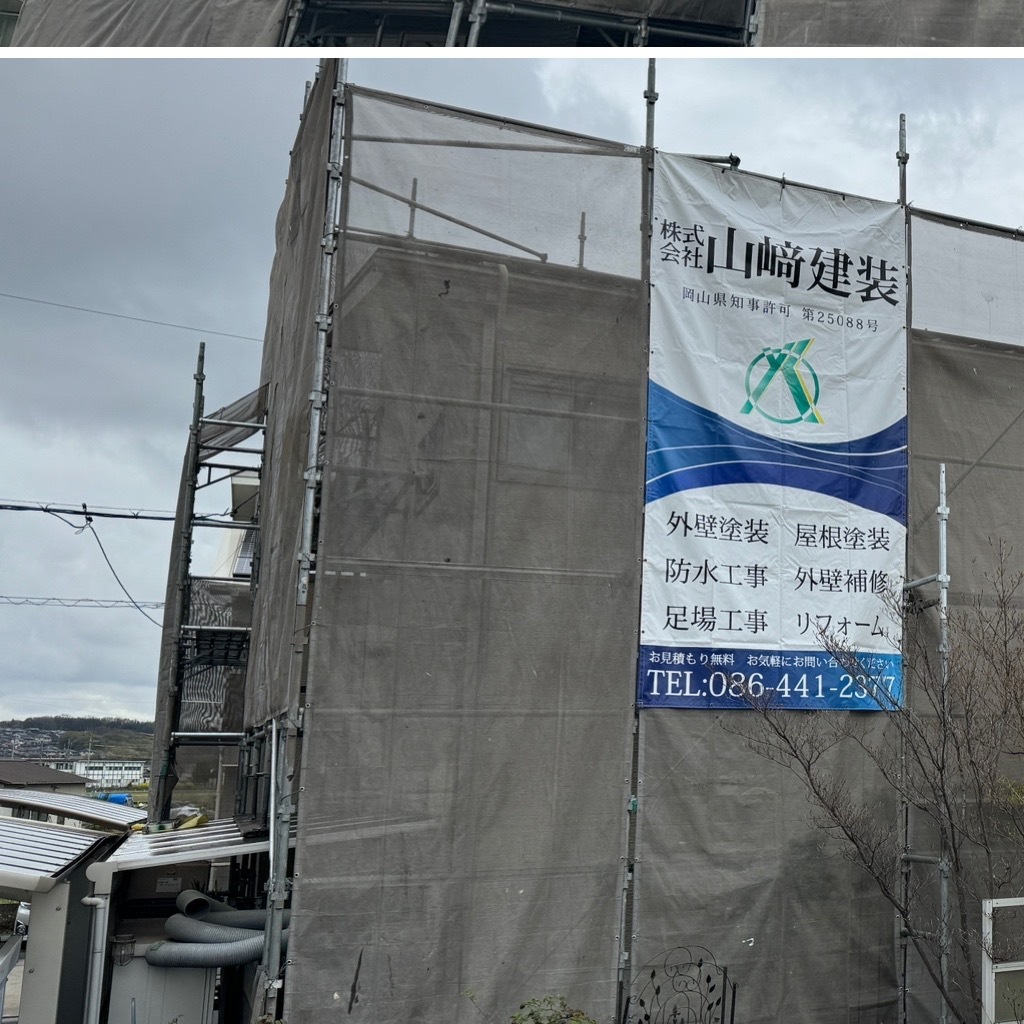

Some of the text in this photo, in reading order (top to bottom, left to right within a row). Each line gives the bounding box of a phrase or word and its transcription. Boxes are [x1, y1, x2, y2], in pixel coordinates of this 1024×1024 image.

[660, 219, 705, 246] 株式
[660, 242, 704, 269] 会社
[682, 286, 878, 333] 岡山県知事許可 第25088号
[666, 511, 890, 551] 外壁塗装 屋根塗装
[665, 558, 888, 594] 防水工事 外壁補修
[662, 605, 884, 636] 足場工事 リフォーム
[649, 650, 894, 669] お見積もり無料 お気軽にお問い合わください
[647, 669, 895, 698] TEL:086-441-2377
